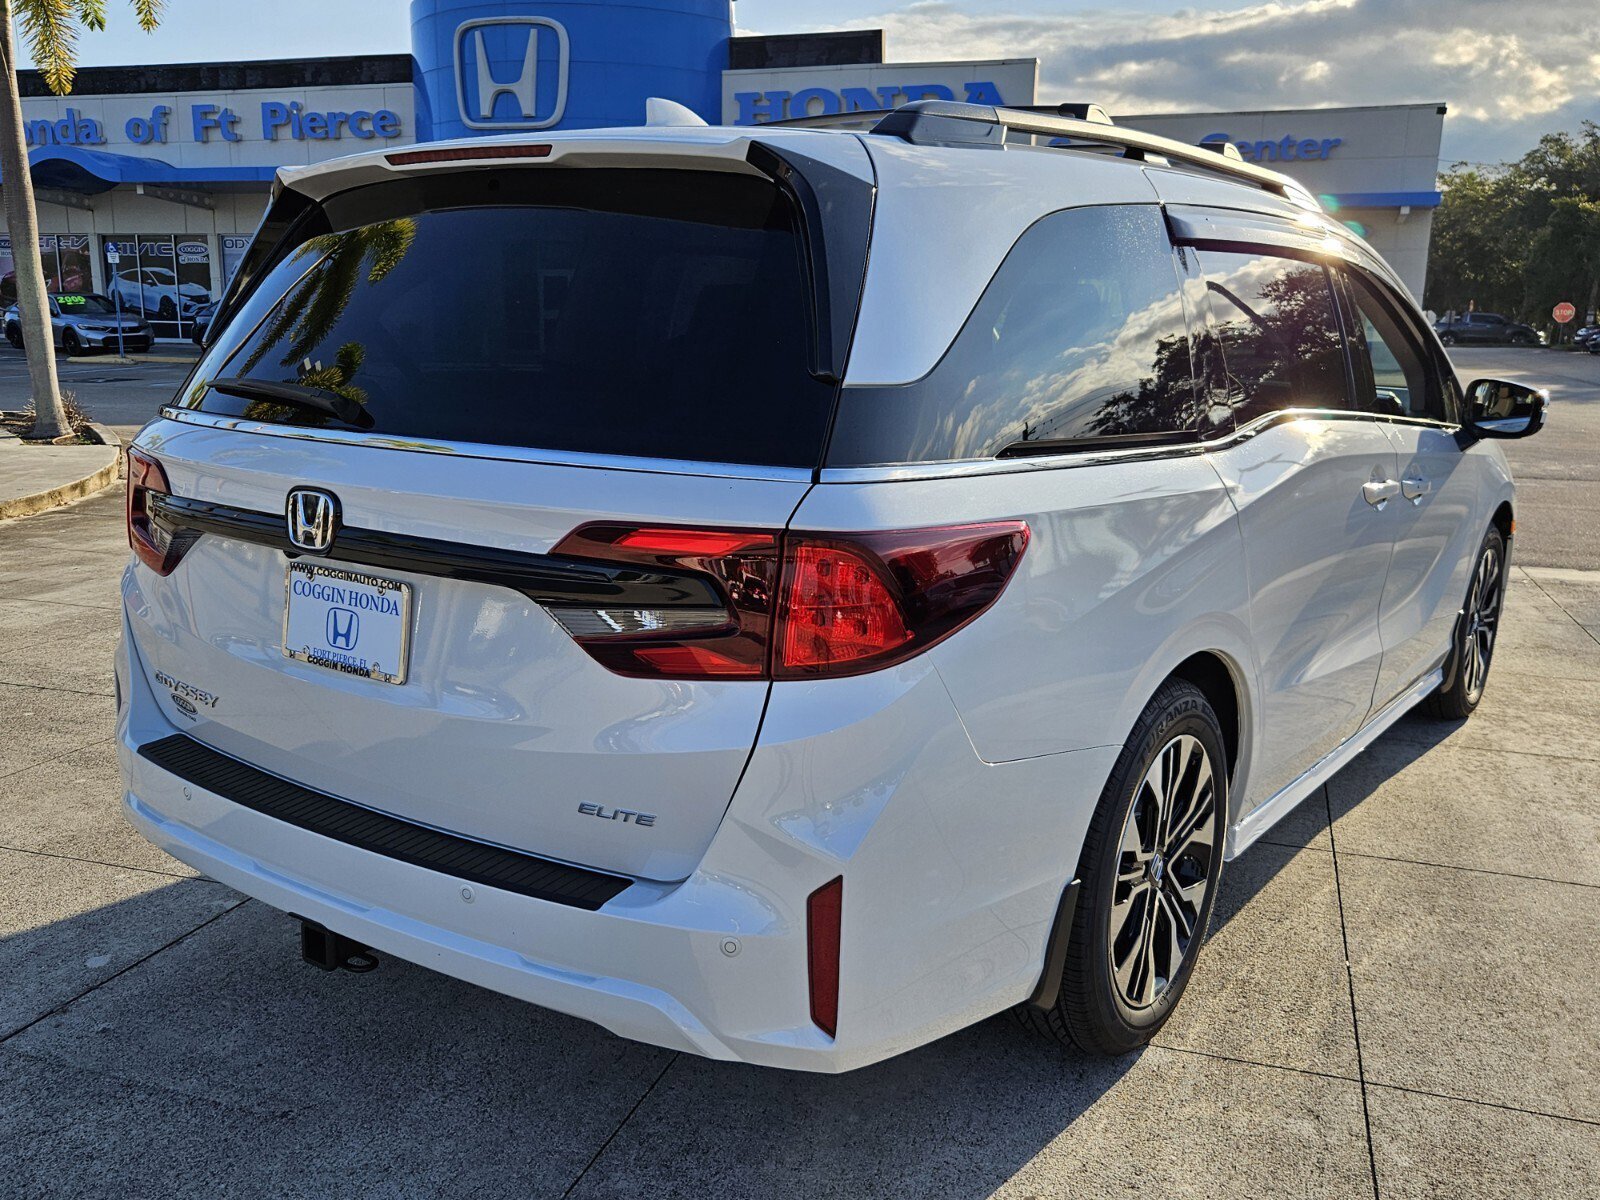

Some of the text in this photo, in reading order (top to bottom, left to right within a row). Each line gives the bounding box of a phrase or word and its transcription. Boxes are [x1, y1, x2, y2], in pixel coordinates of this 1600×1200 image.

[125, 105, 171, 144] of
[191, 104, 241, 142] Ft
[261, 101, 401, 141] Pierce
[118, 242, 173, 256] IVIC
[293, 579, 400, 617] COGGIN HONDA
[307, 655, 371, 679] COGGIN HONDA
[312, 647, 332, 659] FORT
[359, 658, 368, 669] FL
[155, 669, 220, 708] ODYSSEY
[577, 801, 657, 827] ELITE
